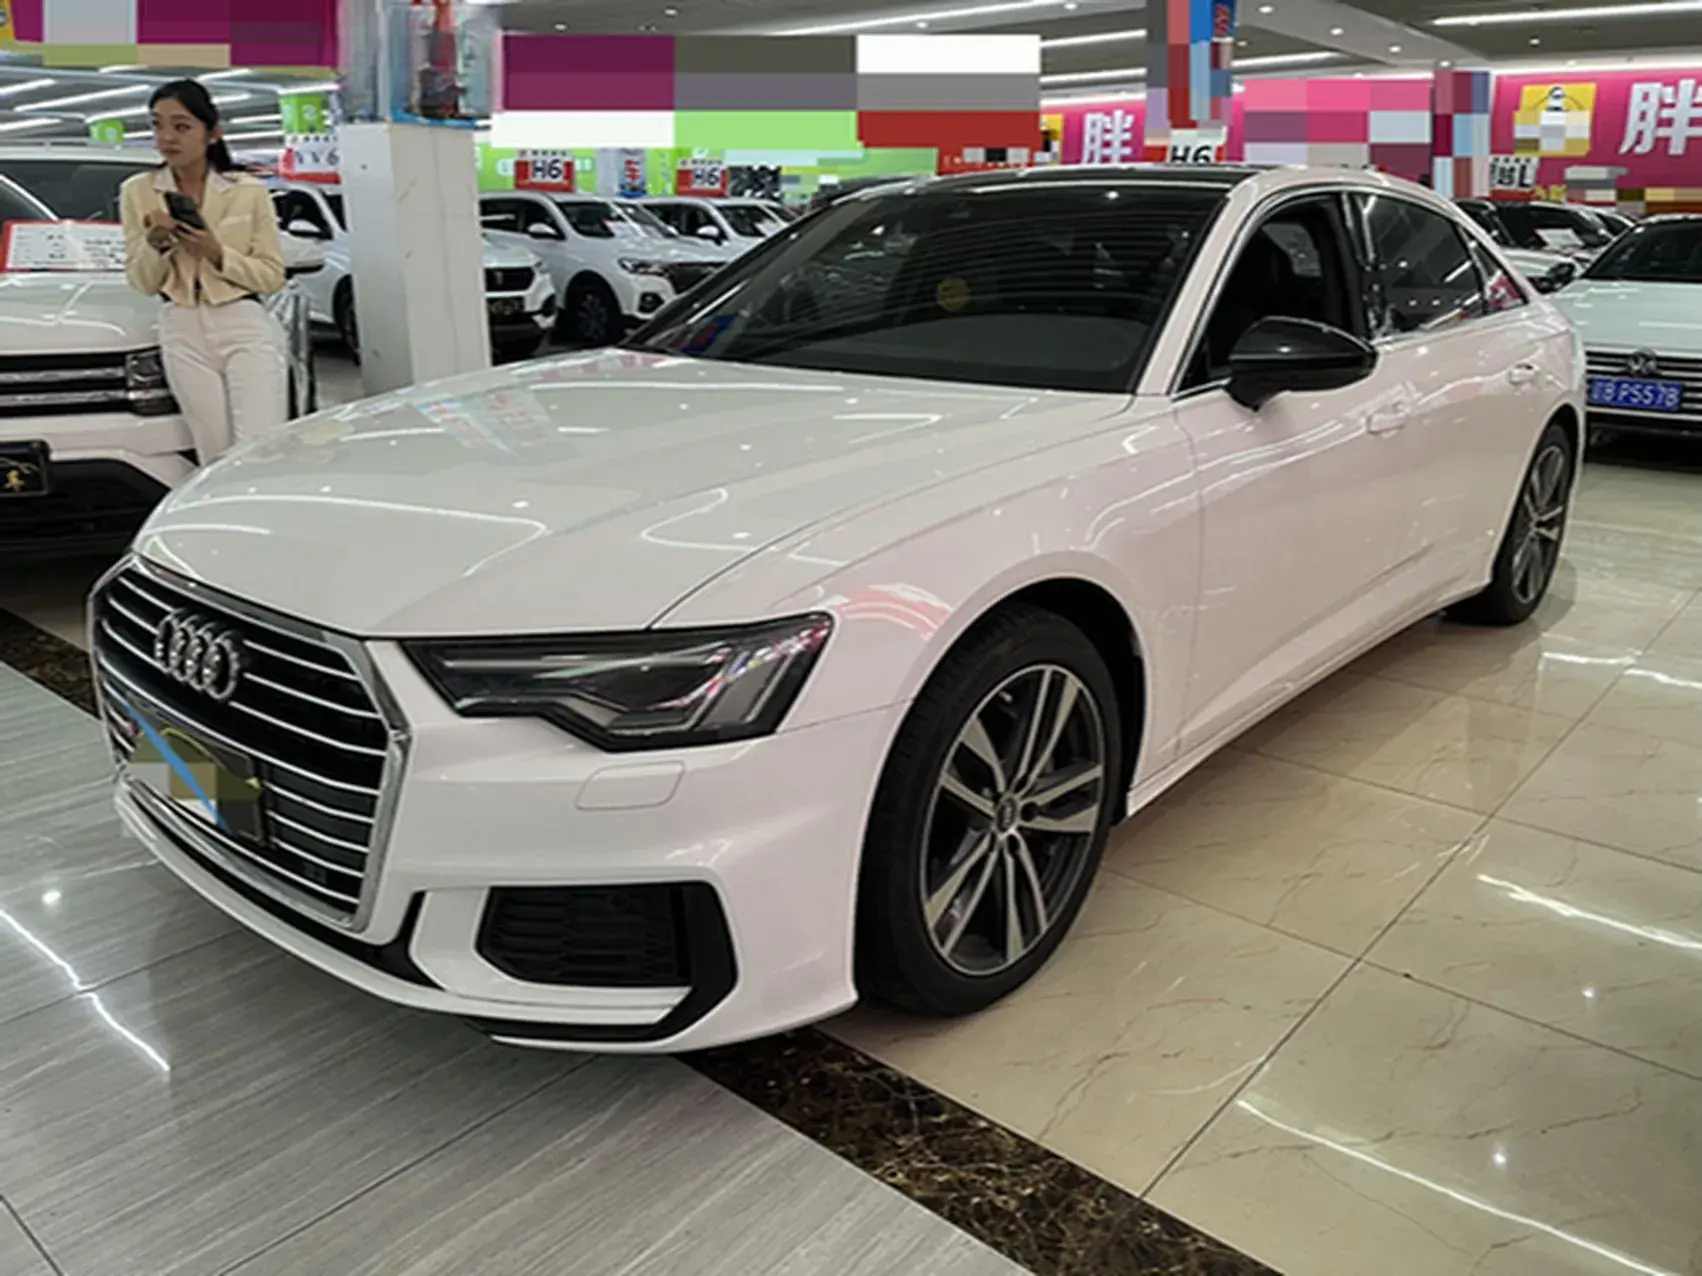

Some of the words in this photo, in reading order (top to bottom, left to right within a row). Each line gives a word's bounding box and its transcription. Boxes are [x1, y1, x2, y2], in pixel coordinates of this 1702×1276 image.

[1618, 78, 1702, 156] 胖
[1082, 109, 1136, 164] 胖
[1170, 145, 1213, 164] H6
[531, 158, 564, 180] H6
[693, 166, 720, 187] H6
